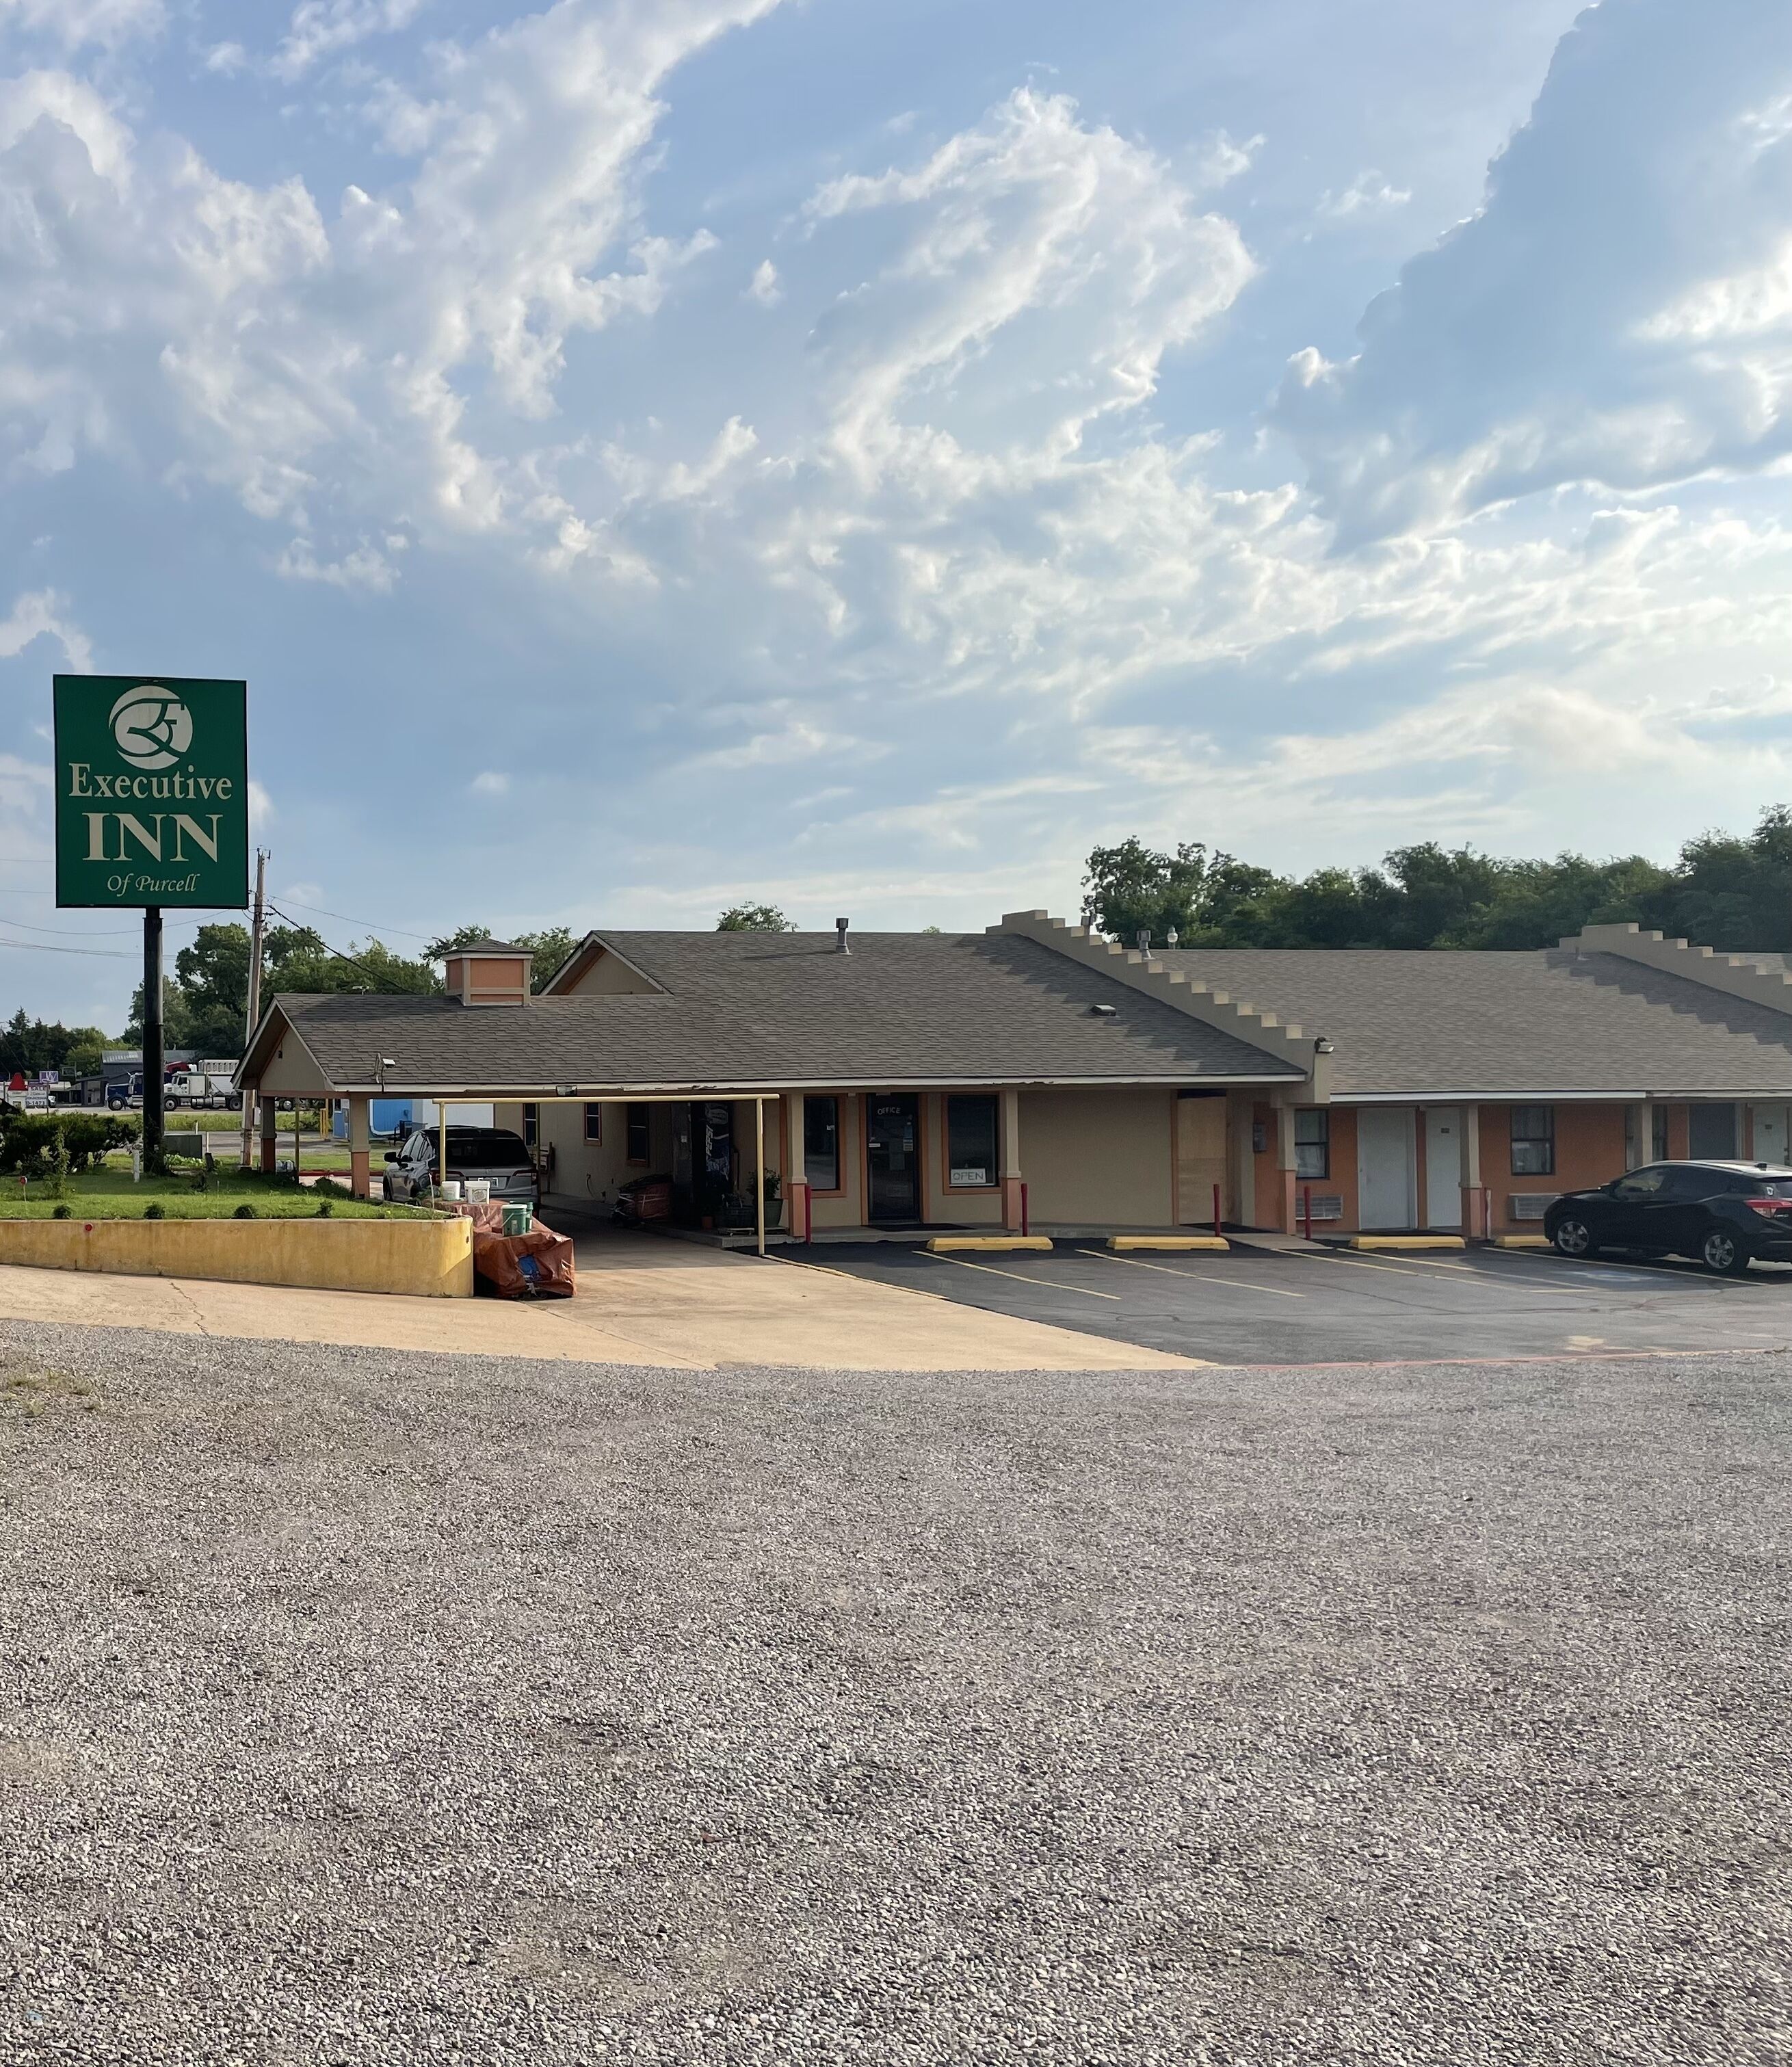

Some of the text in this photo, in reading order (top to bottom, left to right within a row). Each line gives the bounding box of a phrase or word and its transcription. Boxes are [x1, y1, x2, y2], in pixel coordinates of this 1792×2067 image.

[68, 762, 233, 800] Executive
[82, 813, 224, 863] INN
[107, 873, 200, 897] Of Purcell
[877, 1107, 901, 1115] OFFICE
[705, 1124, 713, 1157] PEPSI
[952, 1171, 984, 1181] OPEN
